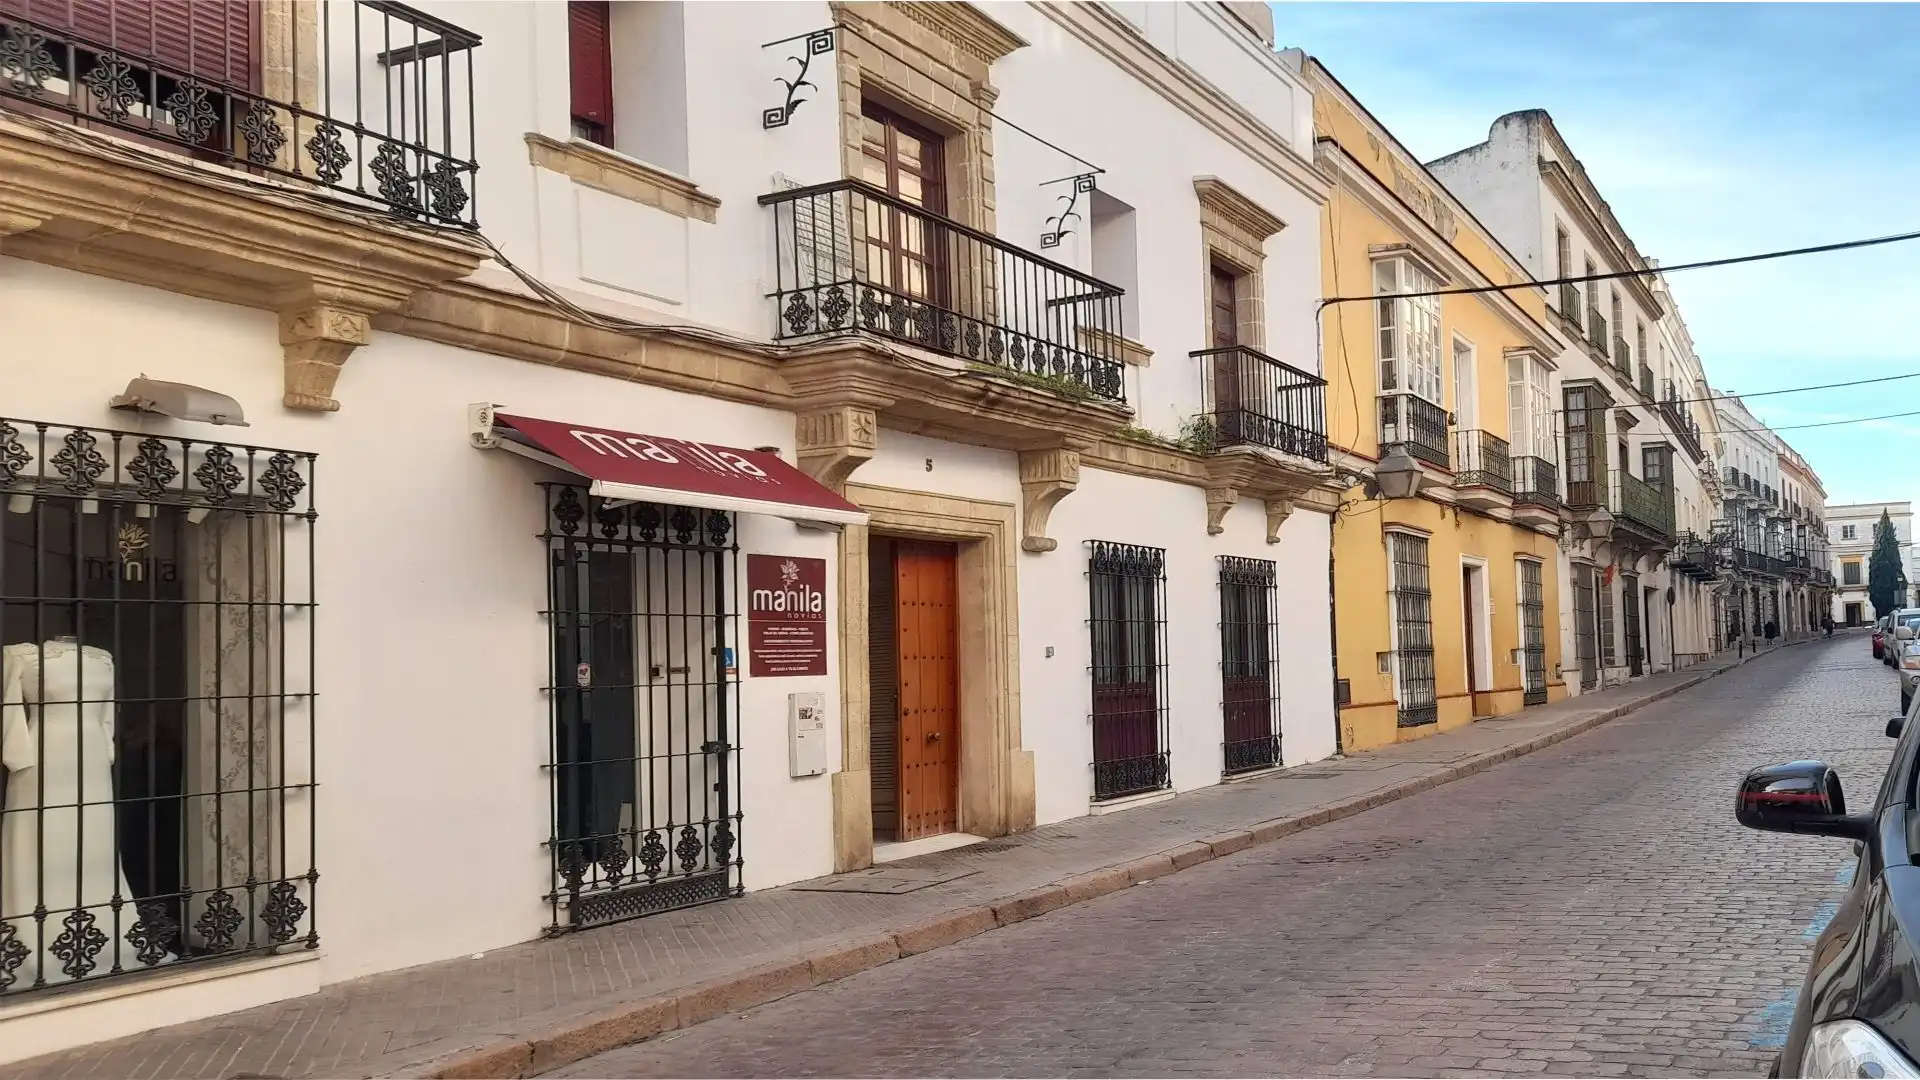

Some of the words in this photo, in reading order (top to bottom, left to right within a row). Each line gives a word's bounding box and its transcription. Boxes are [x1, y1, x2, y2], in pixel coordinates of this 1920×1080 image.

[569, 429, 767, 477] manila
[925, 458, 933, 472] 5
[753, 584, 822, 612] manila
